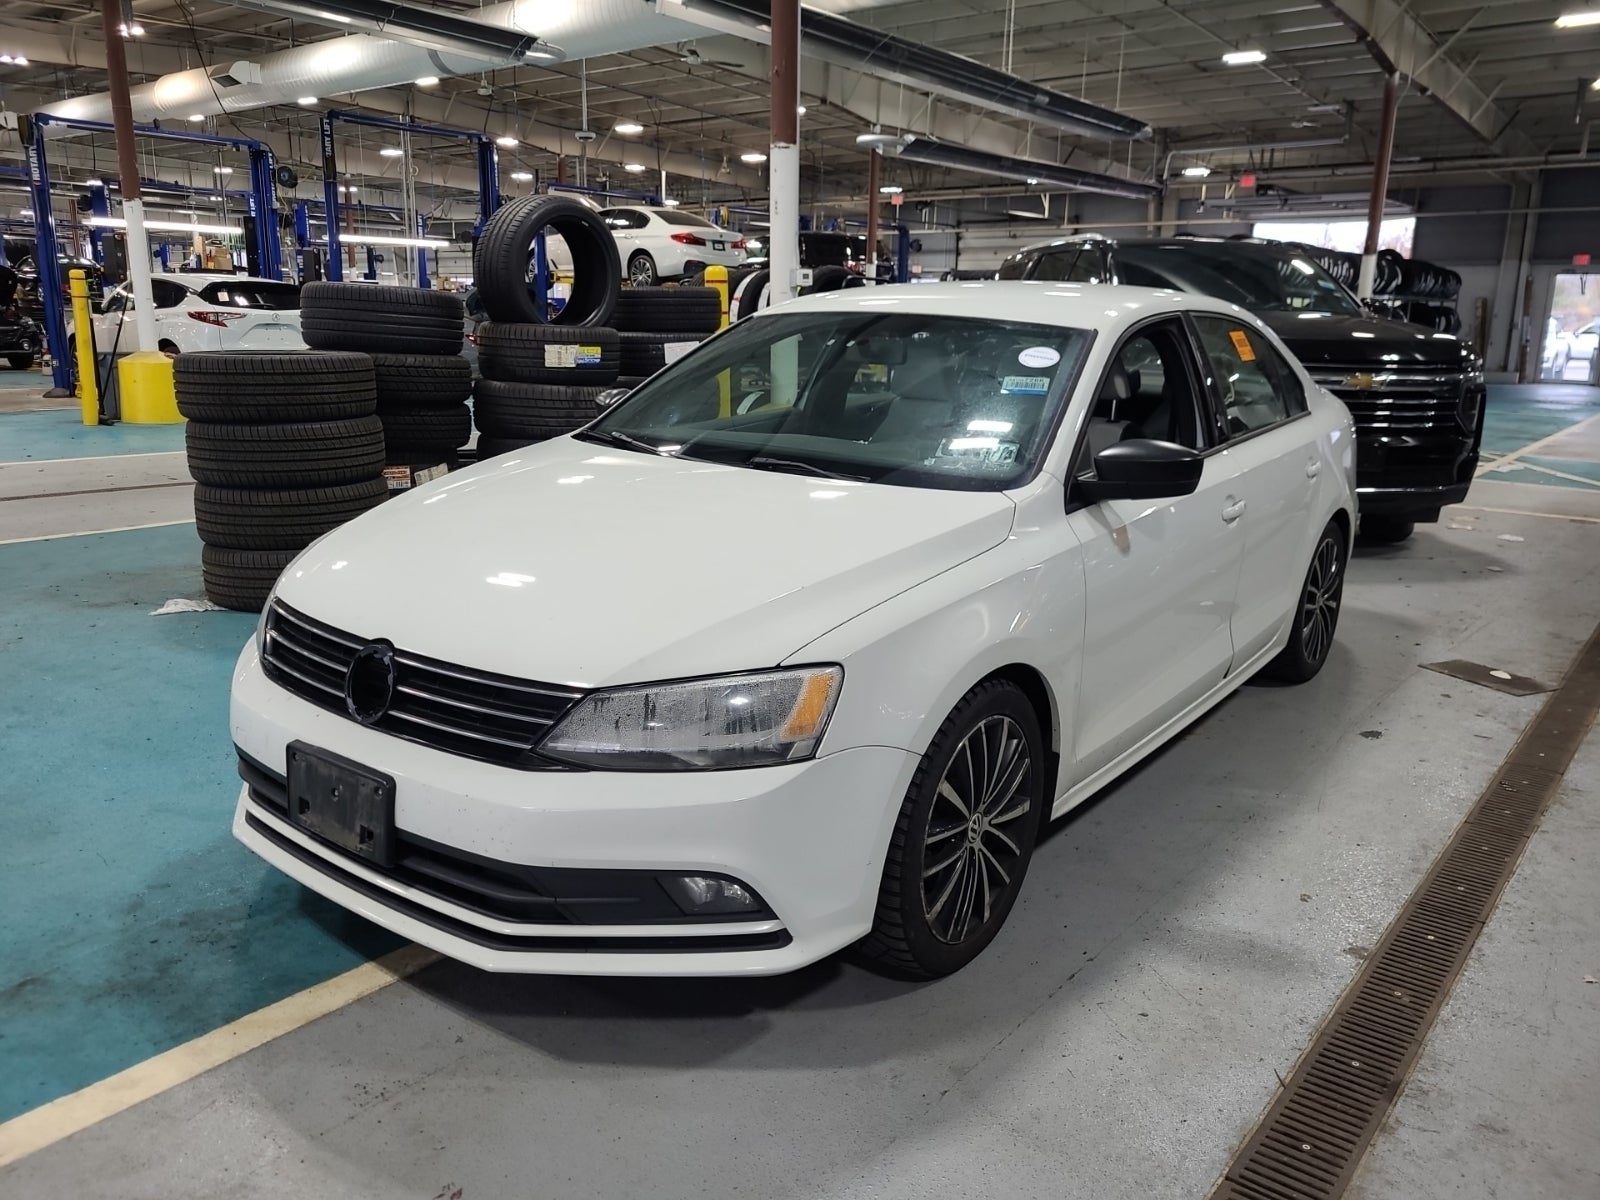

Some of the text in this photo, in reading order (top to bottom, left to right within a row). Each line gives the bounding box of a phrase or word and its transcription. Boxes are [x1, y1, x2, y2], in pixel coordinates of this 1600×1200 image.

[323, 118, 332, 157] TARY LIFT
[29, 145, 40, 180] ROTARY
